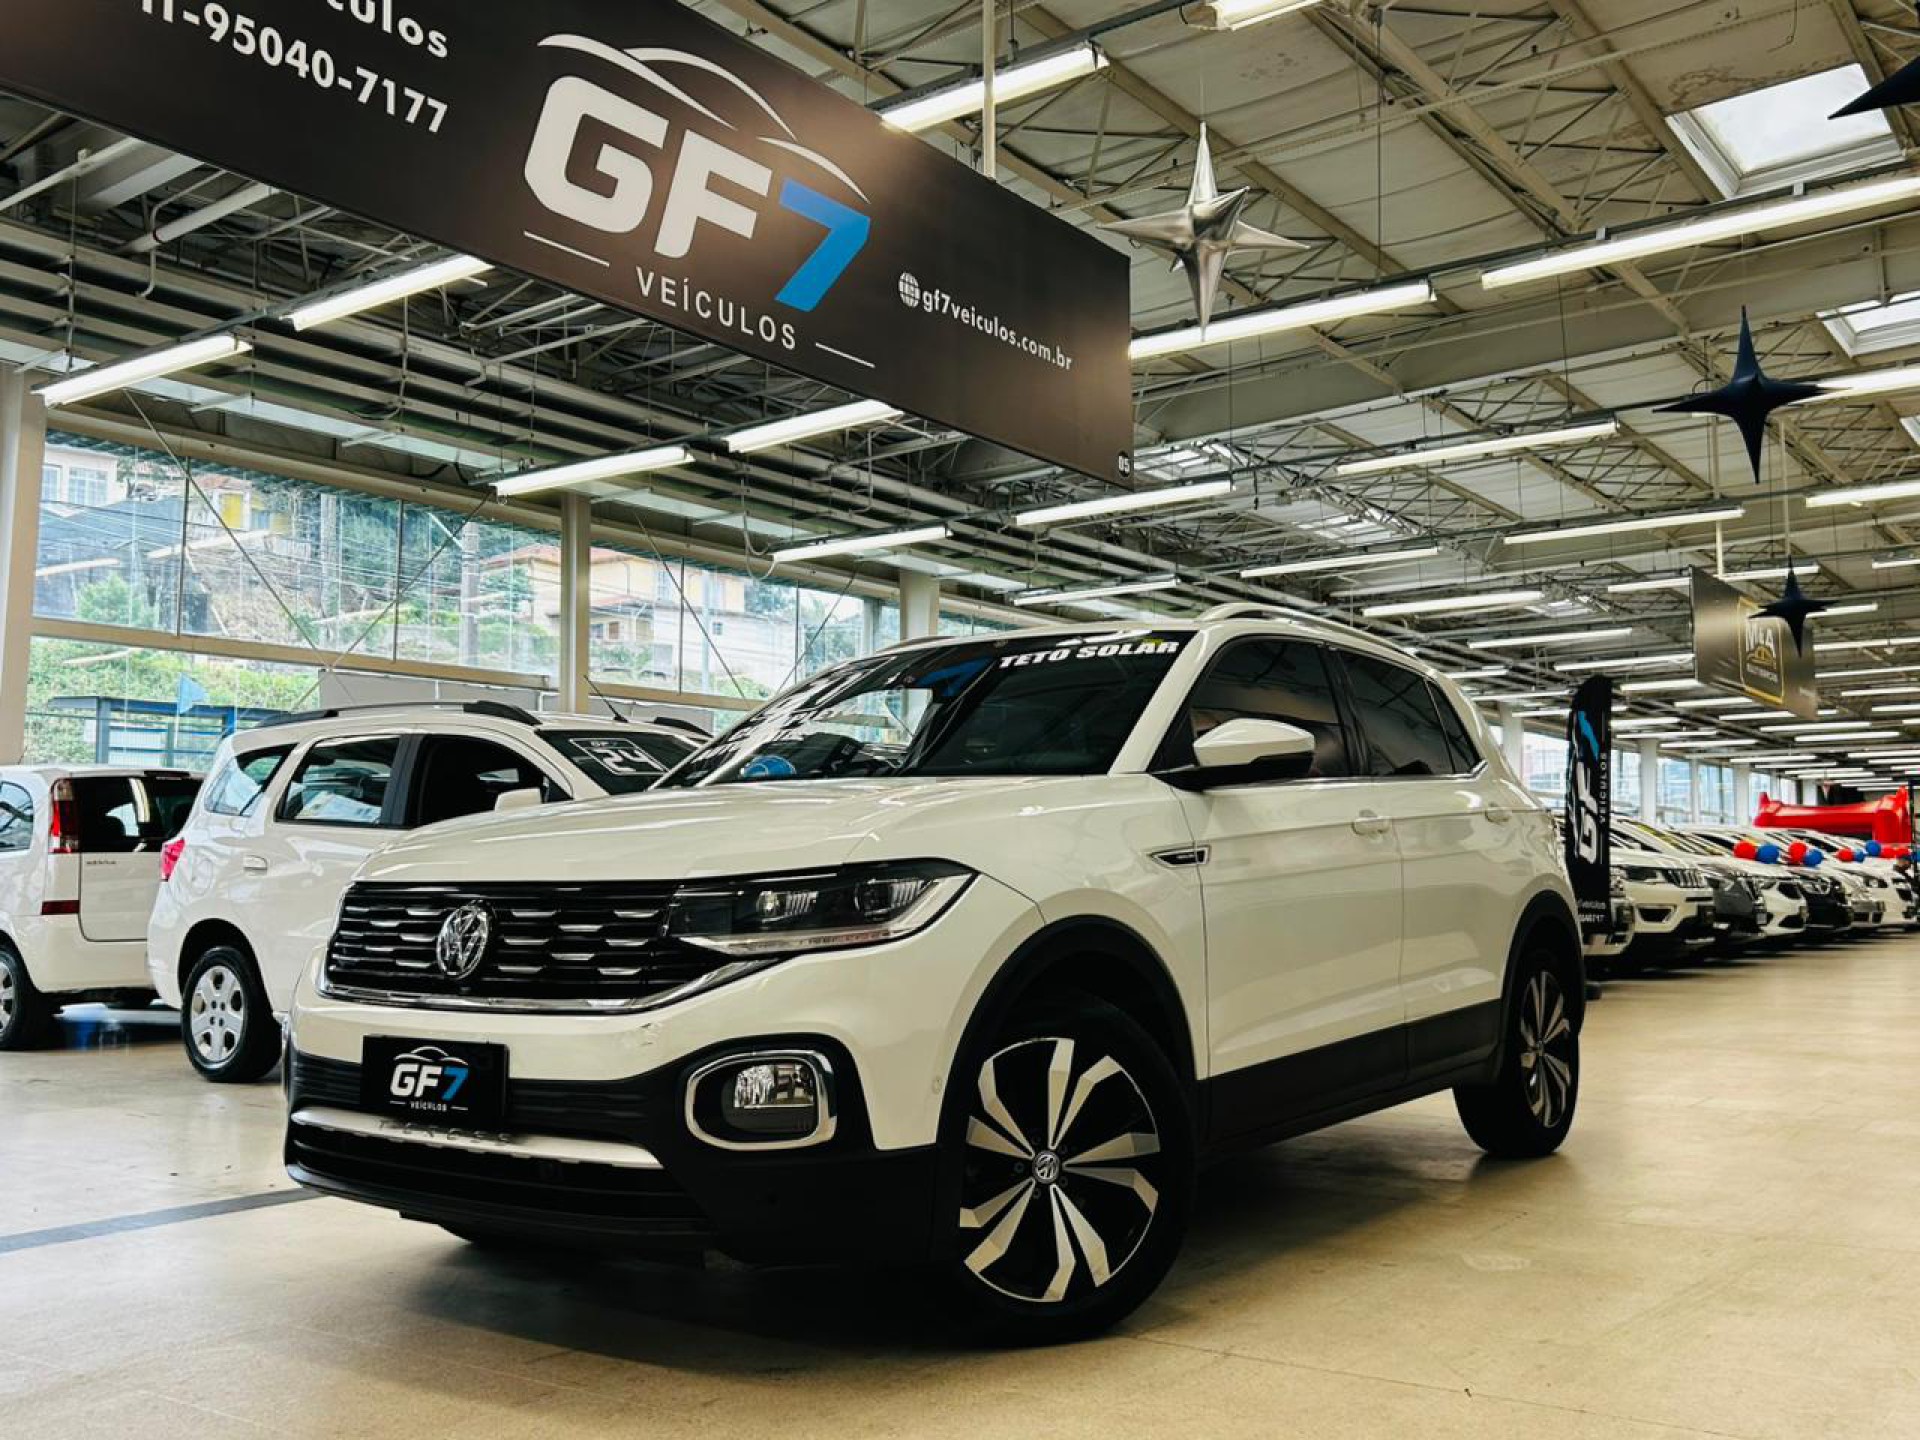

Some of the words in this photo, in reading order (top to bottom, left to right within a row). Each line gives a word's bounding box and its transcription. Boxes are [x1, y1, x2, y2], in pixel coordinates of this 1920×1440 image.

[524, 76, 871, 312] GF7
[635, 266, 797, 350] VEÍCULOS
[922, 288, 1073, 370] gf7veiculos.com.br
[998, 648, 1070, 669] TETO
[1076, 641, 1180, 659] SOLAR
[592, 748, 665, 772] 24
[390, 1063, 469, 1101] GF7
